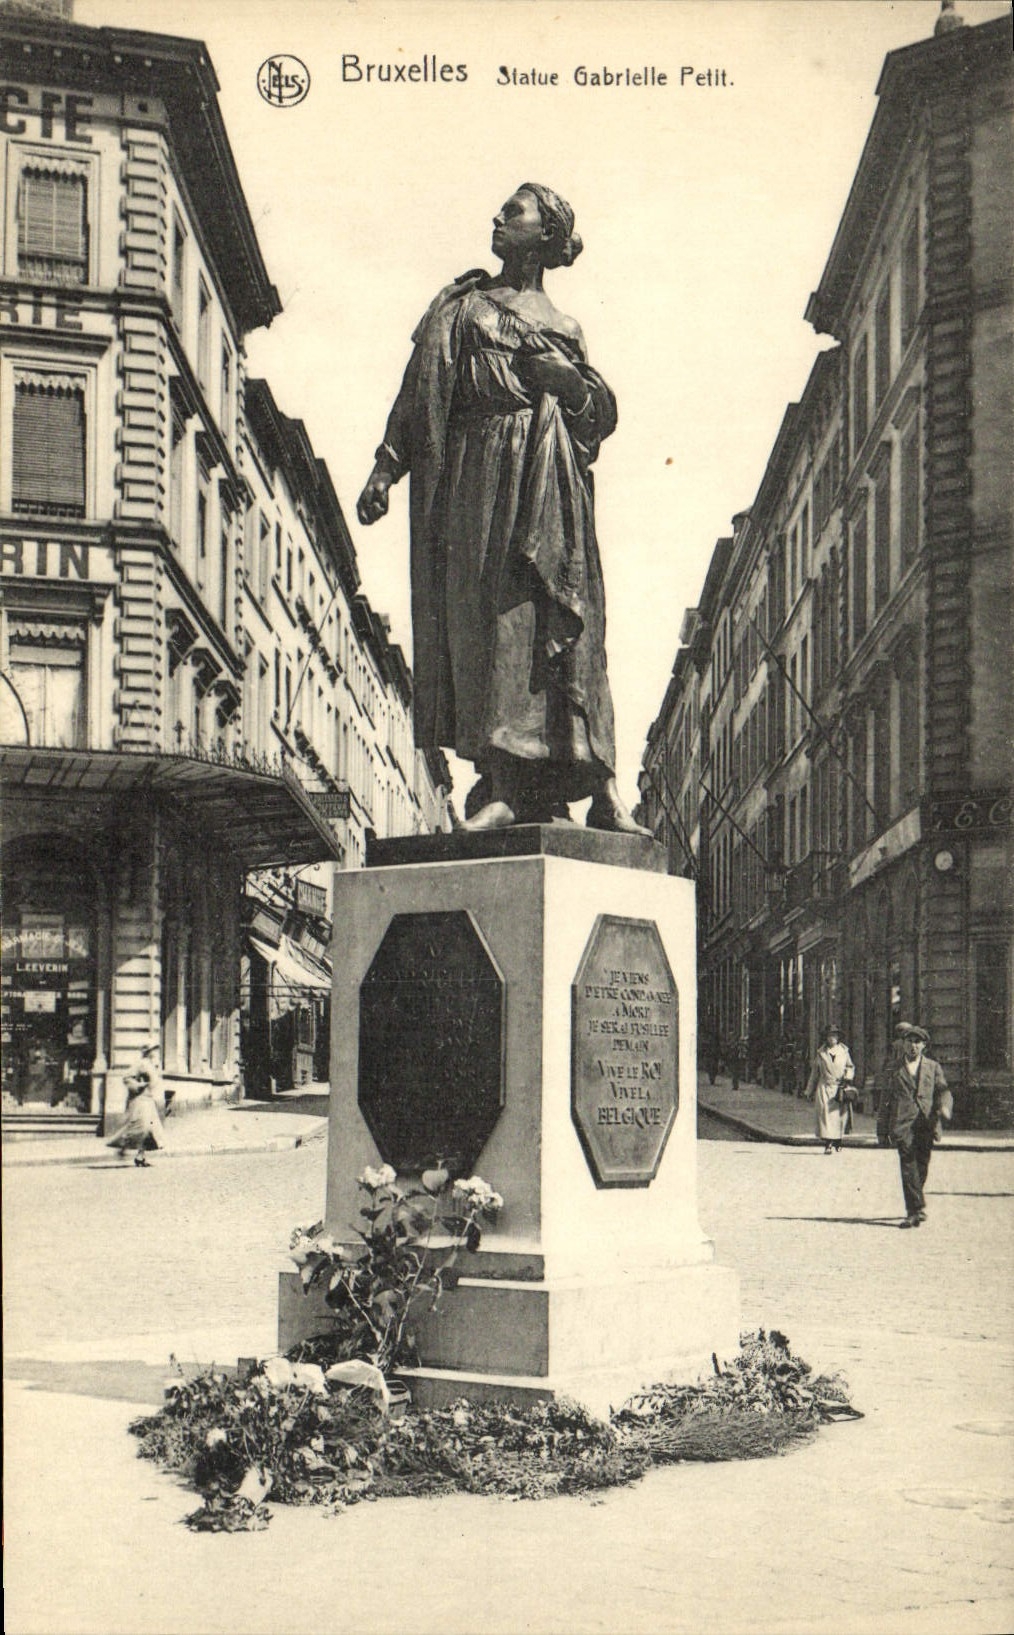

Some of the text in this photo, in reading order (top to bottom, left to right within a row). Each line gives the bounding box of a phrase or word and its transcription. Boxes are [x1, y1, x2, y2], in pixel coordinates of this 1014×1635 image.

[0, 541, 89, 580] RIN
[621, 1001, 650, 1018] MORT
[612, 1038, 649, 1052] DEMAIN
[597, 1059, 624, 1078] VIVE
[626, 1066, 639, 1079] LE
[609, 1081, 636, 1099] VIVE
[597, 1106, 661, 1129] BELGIQUE
